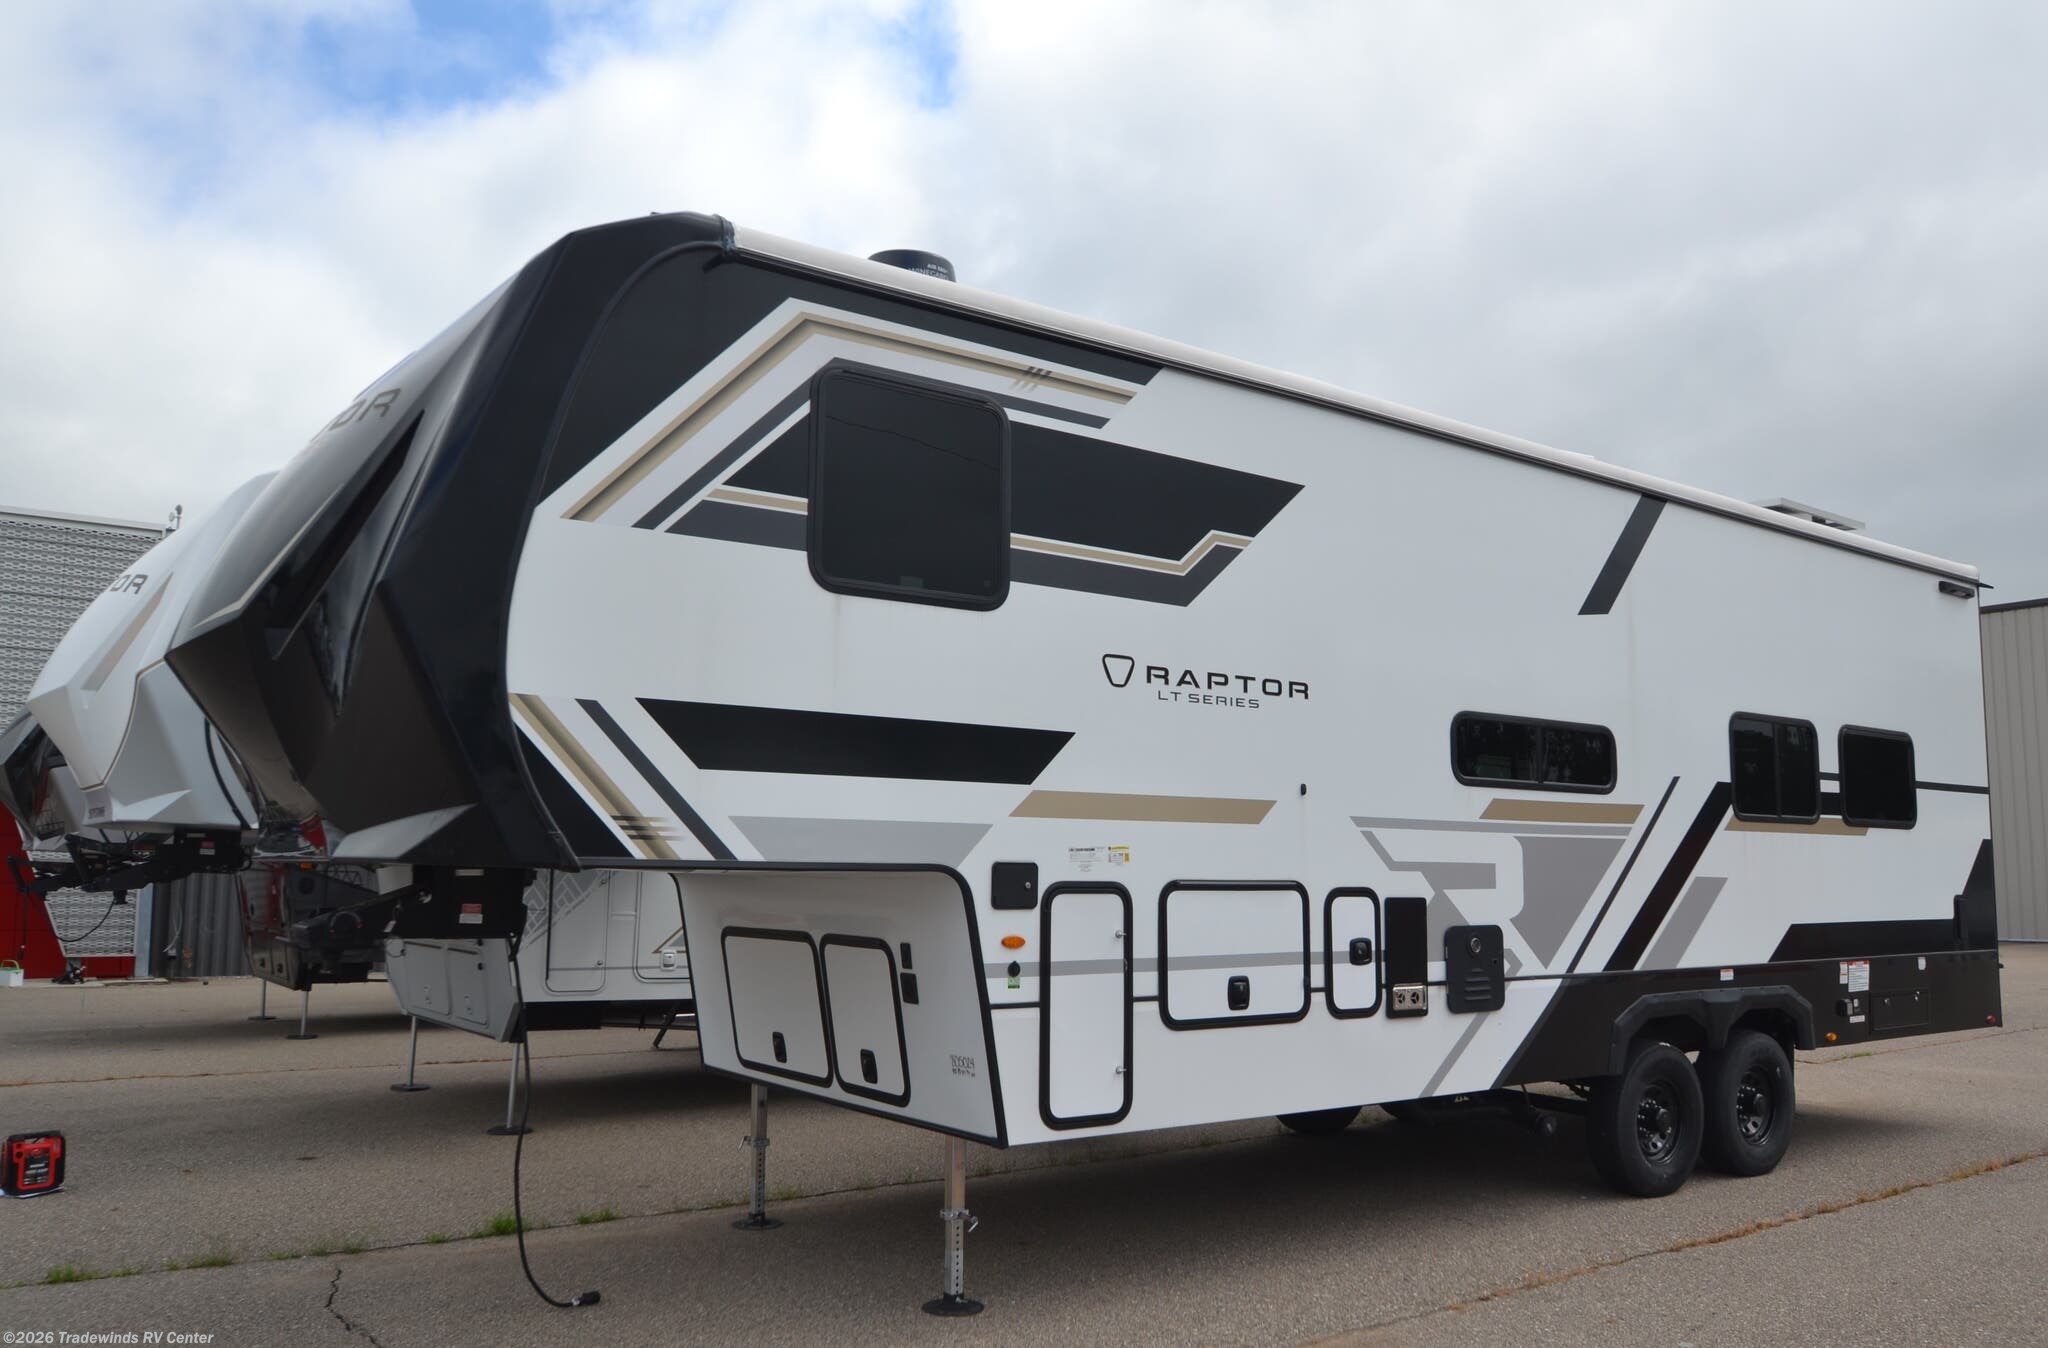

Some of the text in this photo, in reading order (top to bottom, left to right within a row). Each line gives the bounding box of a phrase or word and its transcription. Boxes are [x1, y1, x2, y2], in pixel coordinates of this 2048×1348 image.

[1146, 665, 1309, 700] RAPTOR
[1158, 690, 1260, 709] LT SERIES
